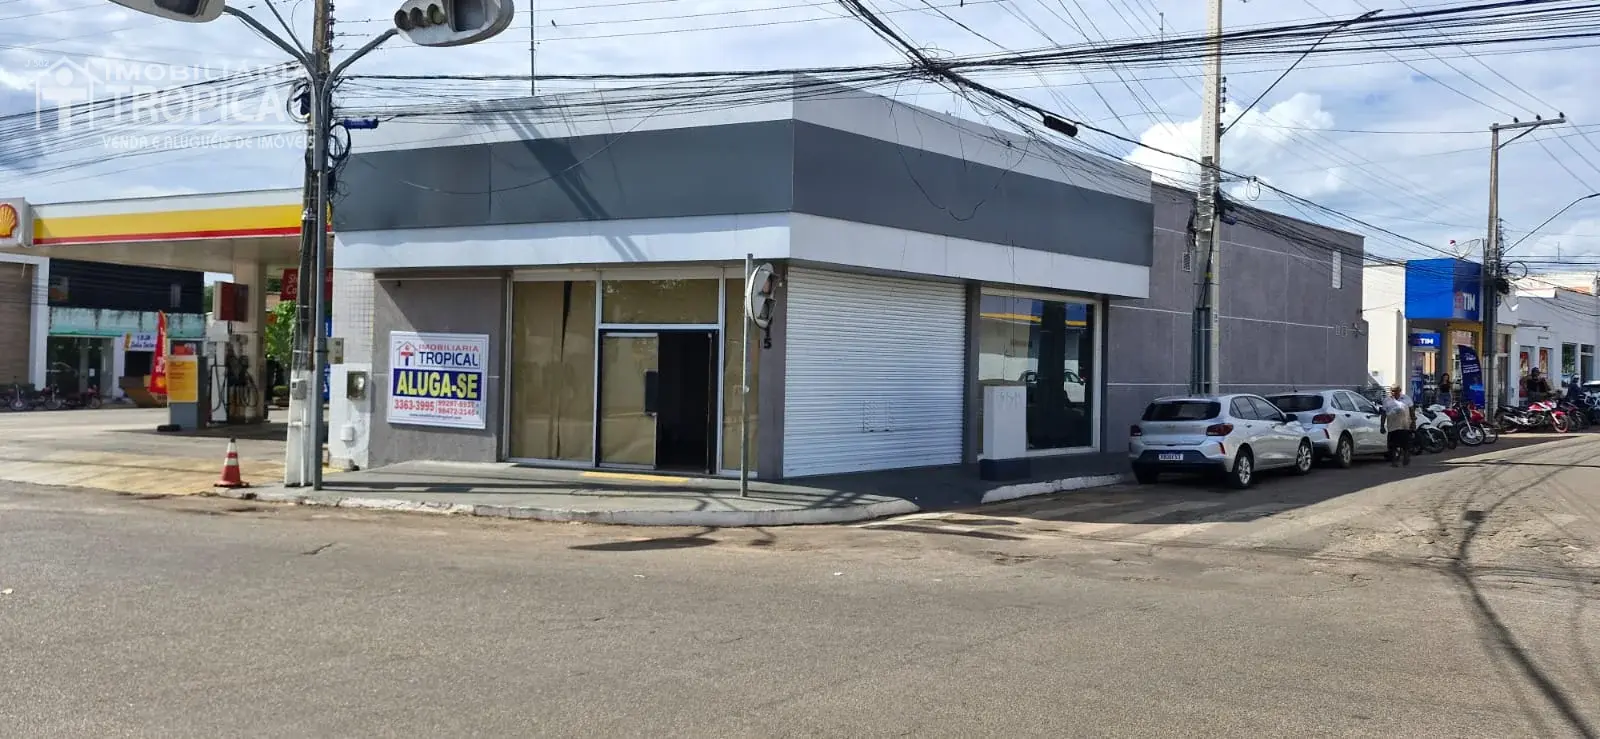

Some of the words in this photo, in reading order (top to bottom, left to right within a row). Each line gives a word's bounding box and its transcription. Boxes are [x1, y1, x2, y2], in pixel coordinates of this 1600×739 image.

[1463, 292, 1476, 311] TIM
[418, 351, 479, 366] TROPICAL
[396, 371, 477, 398] ALUGA-SE
